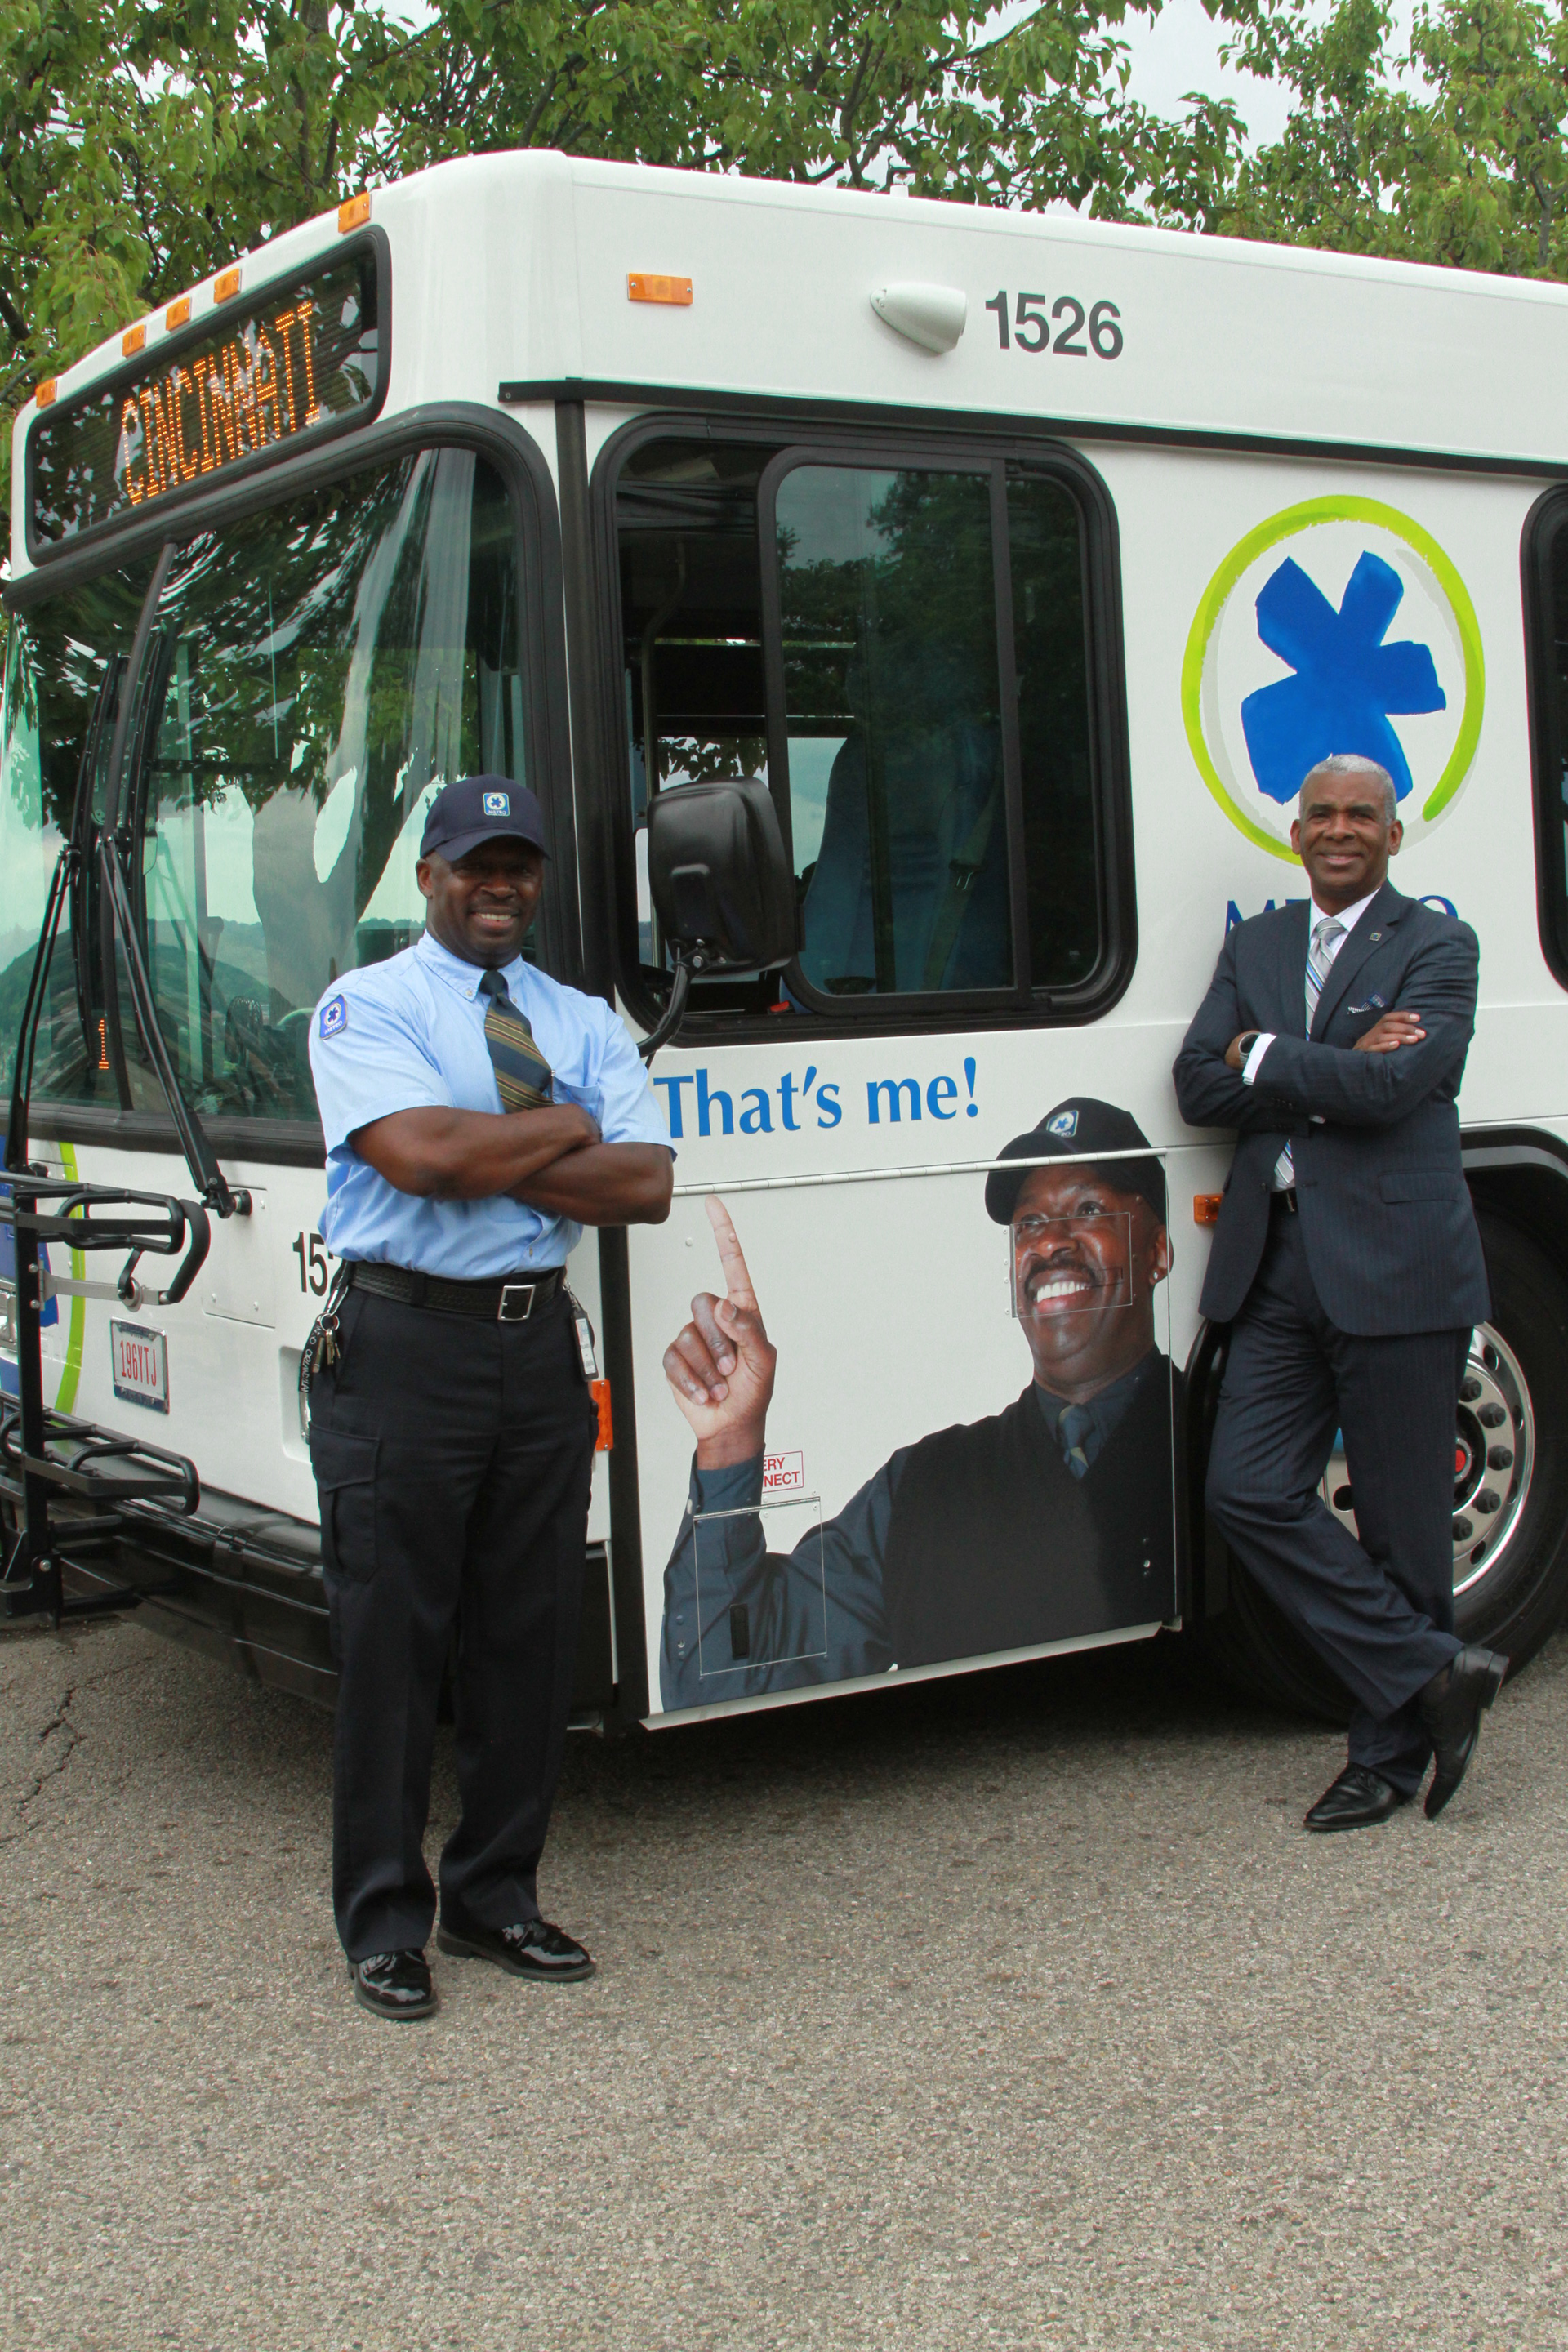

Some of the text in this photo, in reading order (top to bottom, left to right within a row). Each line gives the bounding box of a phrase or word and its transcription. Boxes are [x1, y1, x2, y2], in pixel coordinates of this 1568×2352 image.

[985, 289, 1124, 360] 1526
[122, 300, 321, 506] CINCINNATI
[324, 1020, 343, 1035] METRO
[653, 1056, 979, 1139] That's me!
[120, 1339, 157, 1387] 196YTJ
[764, 1471, 800, 1488] NECT
